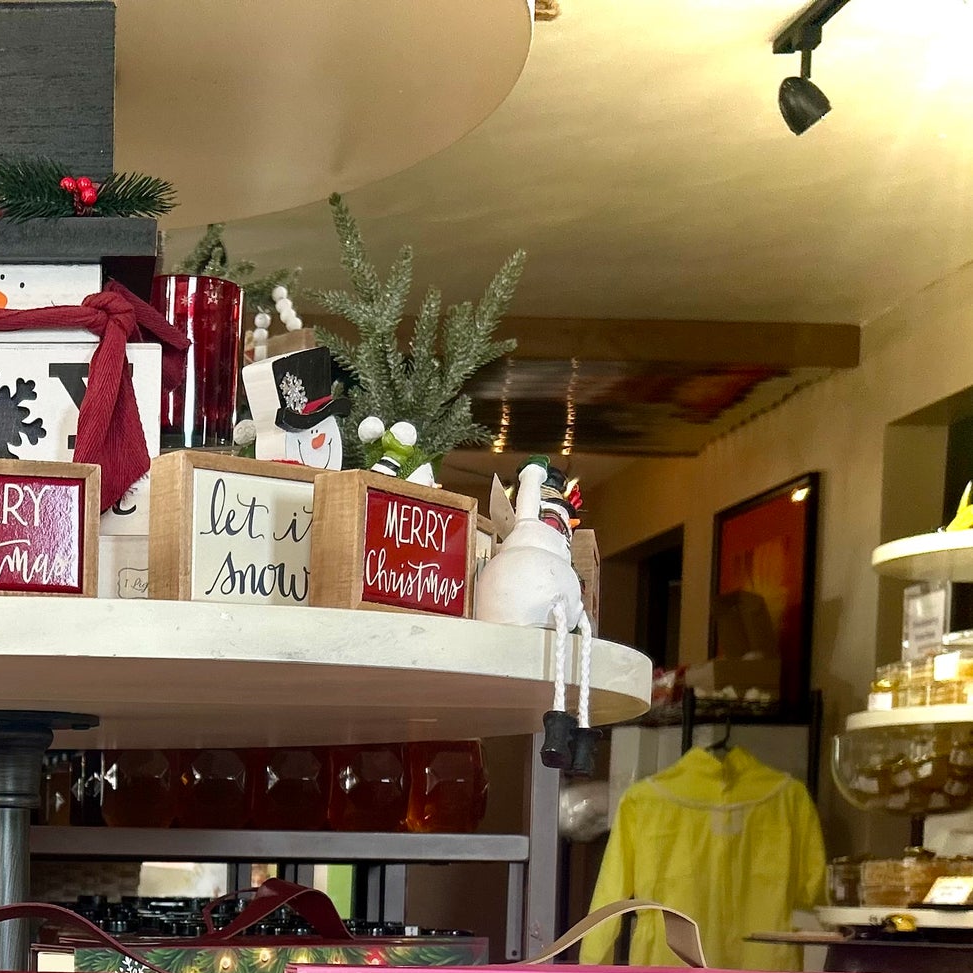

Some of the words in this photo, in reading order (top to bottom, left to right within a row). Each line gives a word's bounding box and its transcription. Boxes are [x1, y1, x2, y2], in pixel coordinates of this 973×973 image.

[199, 478, 268, 539] let
[273, 506, 313, 542] i
[383, 501, 453, 553] MERRY
[205, 551, 310, 602] snow
[365, 549, 465, 607] Christmas
